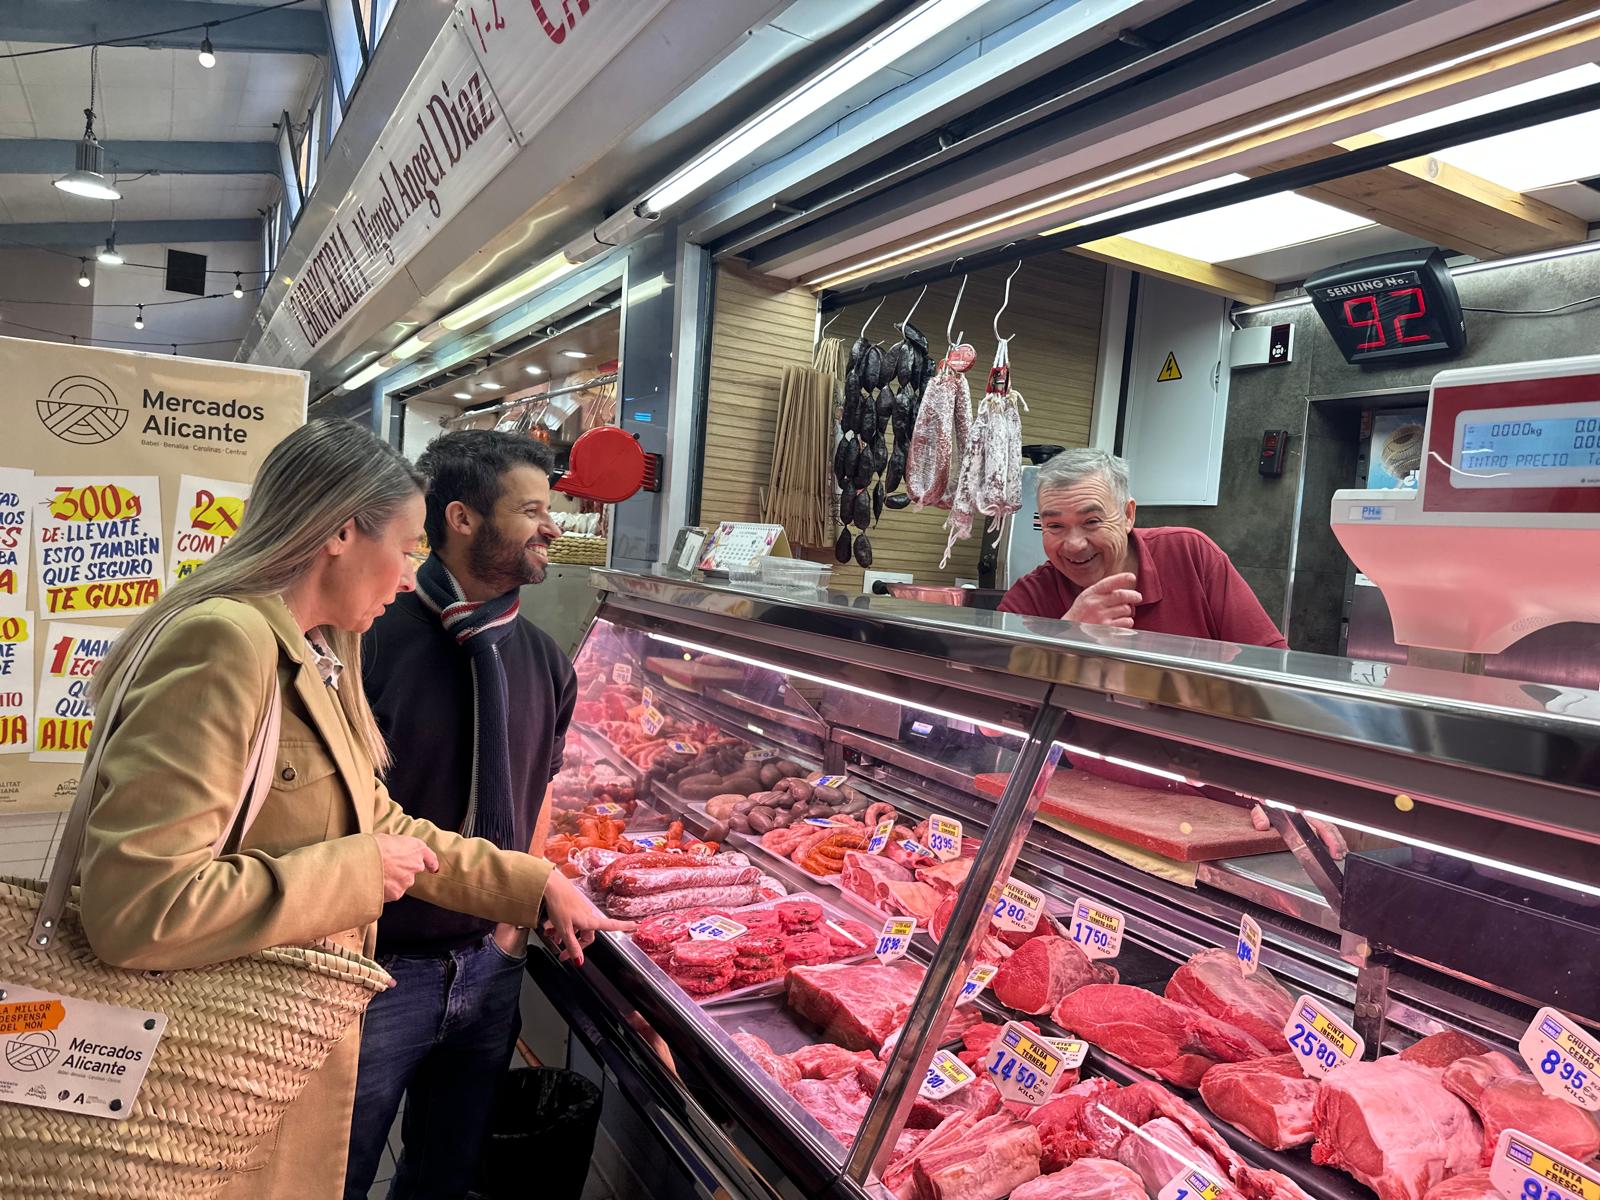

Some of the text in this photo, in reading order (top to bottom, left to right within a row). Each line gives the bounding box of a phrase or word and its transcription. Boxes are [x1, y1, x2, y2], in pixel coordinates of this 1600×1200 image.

[352, 172, 404, 265] Miguel
[389, 113, 446, 218] Angel
[1326, 280, 1384, 297] SERVING
[1343, 287, 1431, 349] 92
[142, 389, 265, 421] Mercados
[142, 414, 248, 443] Alicante
[1468, 455, 1508, 468] INTRO
[1515, 453, 1569, 467] PRECIO
[54, 484, 142, 520] 300g
[43, 546, 84, 565] ESTO
[43, 558, 152, 586] QUE SEGURO
[47, 579, 159, 613] TE GUSTA
[50, 636, 74, 673] 1
[1007, 891, 1031, 908] TERNERA
[15, 1003, 51, 1013] MILLOR
[1, 1023, 17, 1032] DEL
[1320, 1027, 1345, 1050] IBERICA
[1326, 1022, 1345, 1041] CINTA
[69, 1037, 143, 1062] Mercados
[1021, 1049, 1048, 1072] TERNERA
[1029, 1044, 1048, 1061] FALDA
[1568, 1046, 1595, 1070] CERDO
[62, 1054, 126, 1076] Alicante
[1545, 1169, 1584, 1197] FRESCA
[1552, 1163, 1582, 1184] CINTA
